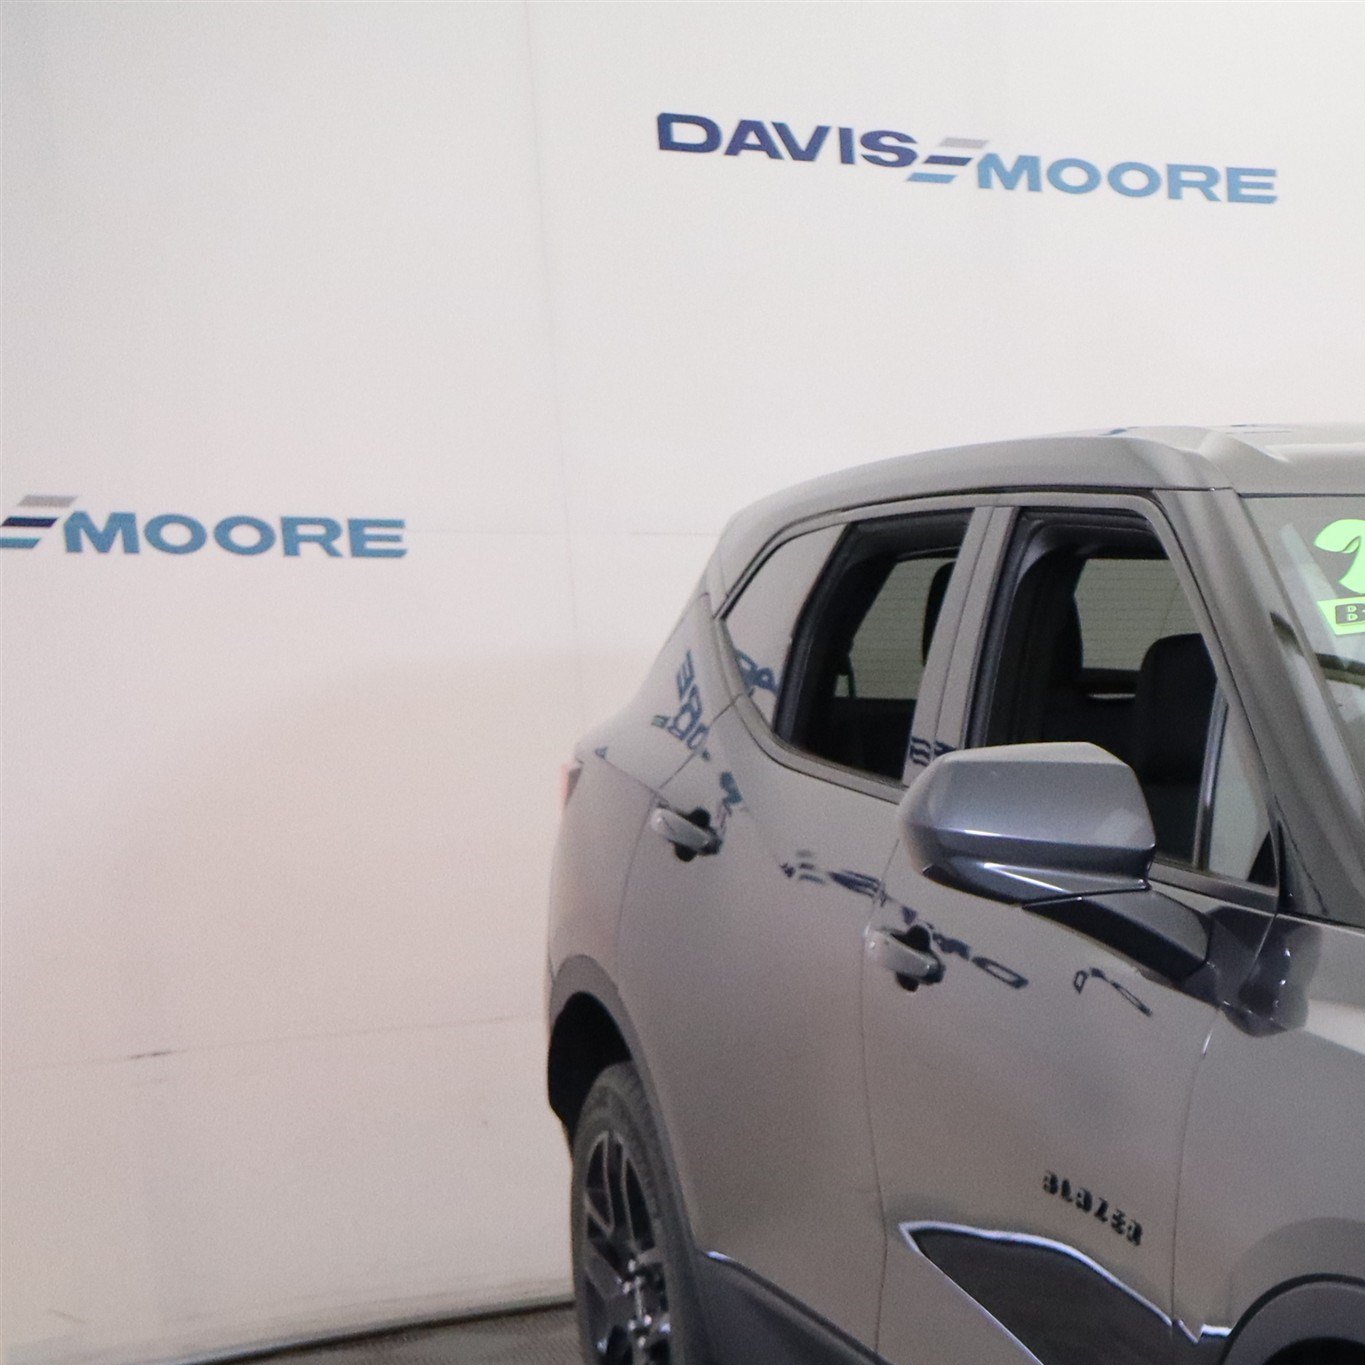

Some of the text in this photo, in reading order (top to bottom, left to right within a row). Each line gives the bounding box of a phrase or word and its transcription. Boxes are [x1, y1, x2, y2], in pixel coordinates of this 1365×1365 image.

[656, 112, 1278, 204] DAVIS MOORE
[62, 510, 408, 559] MOORE
